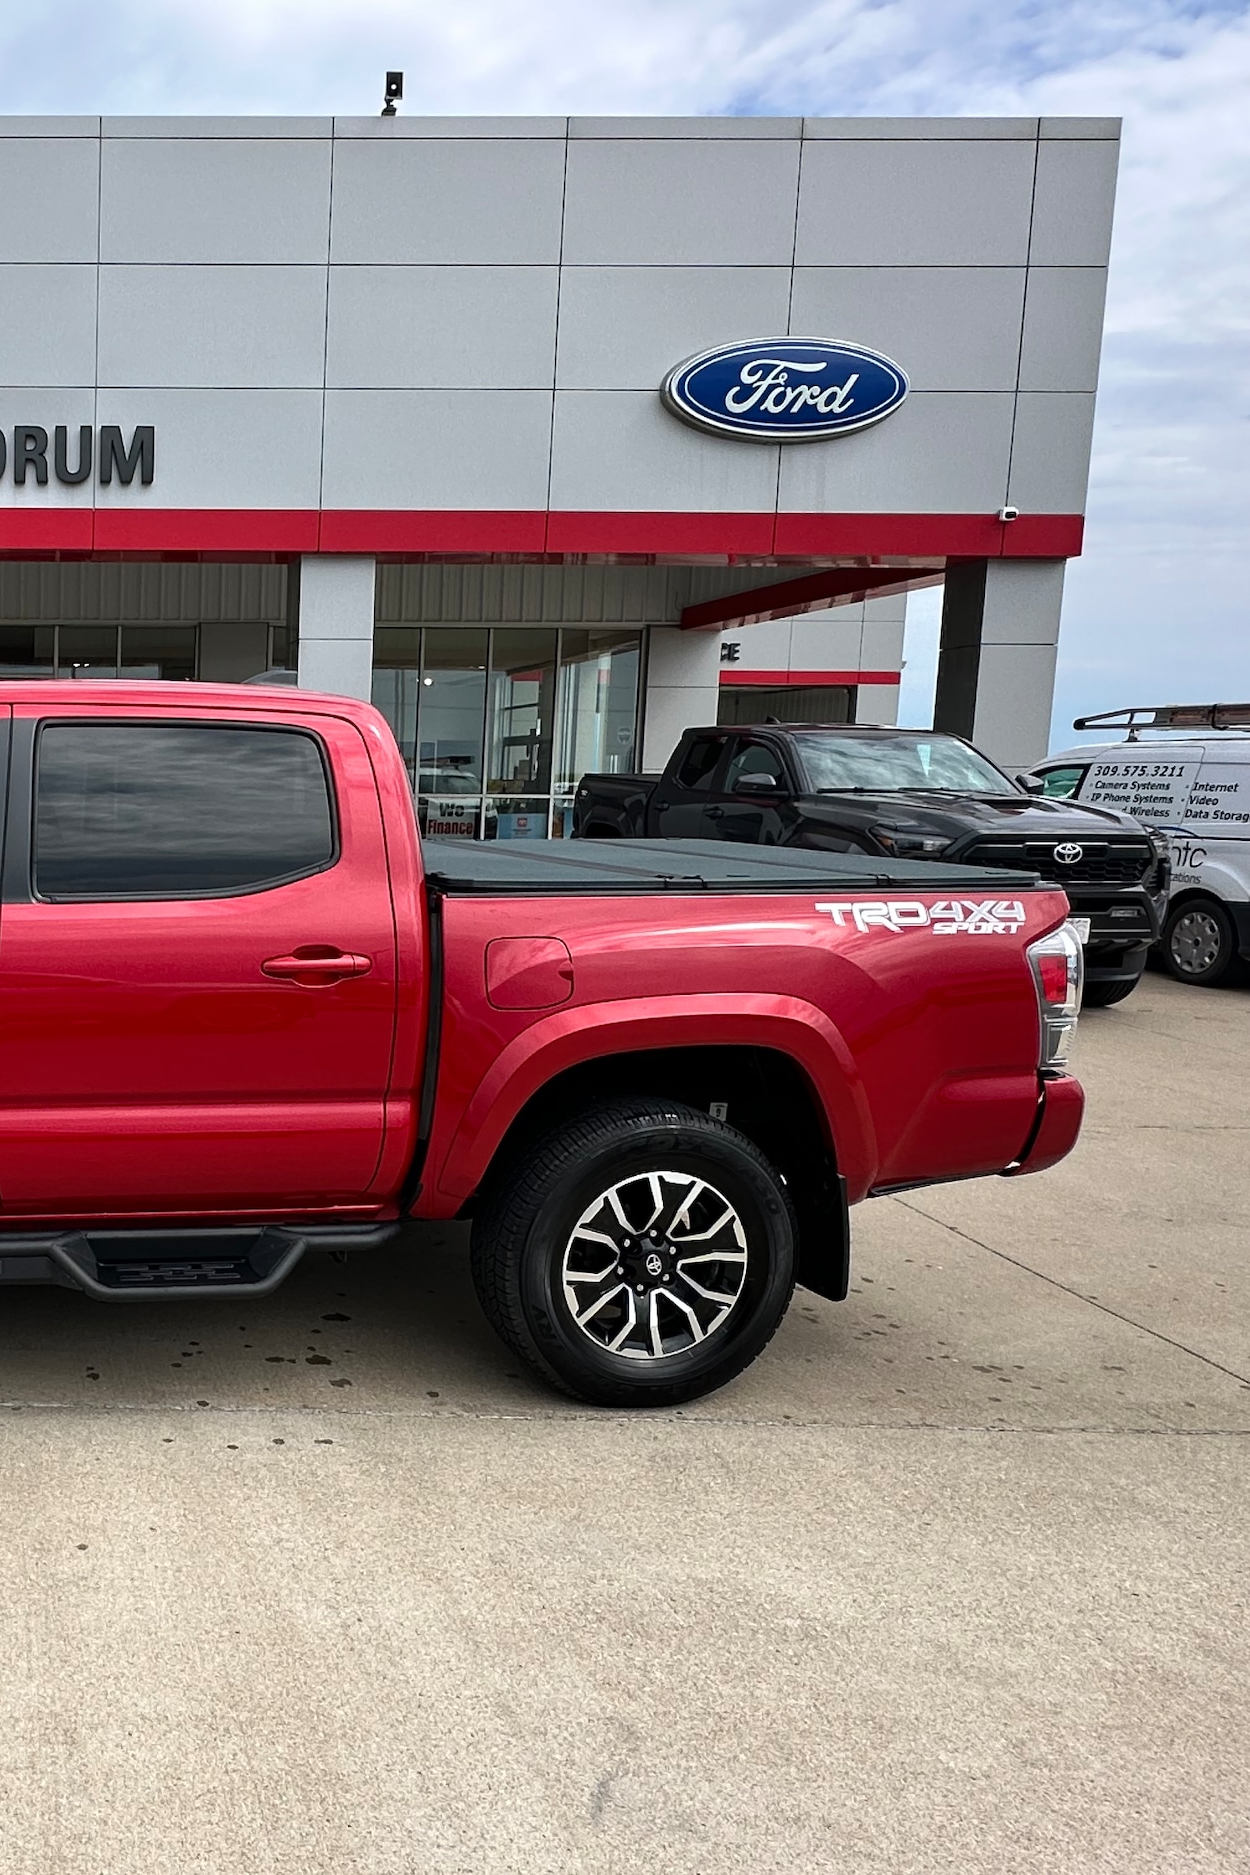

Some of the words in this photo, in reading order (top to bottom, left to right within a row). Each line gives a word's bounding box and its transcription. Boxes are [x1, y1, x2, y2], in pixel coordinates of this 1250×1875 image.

[725, 358, 860, 414] Ford
[1094, 765, 1185, 778] 309.575.3211
[1094, 780, 1129, 790] Camera
[1129, 780, 1171, 792] Systems
[1192, 782, 1240, 793] Internet
[1102, 793, 1131, 803] Phone
[1132, 794, 1175, 805] Systems
[1188, 795, 1219, 806] Video
[1129, 806, 1171, 818] Wireless
[1184, 809, 1210, 819] Data
[427, 819, 474, 835] Finance
[814, 901, 931, 934] TRD
[932, 921, 1026, 935] SPORT
